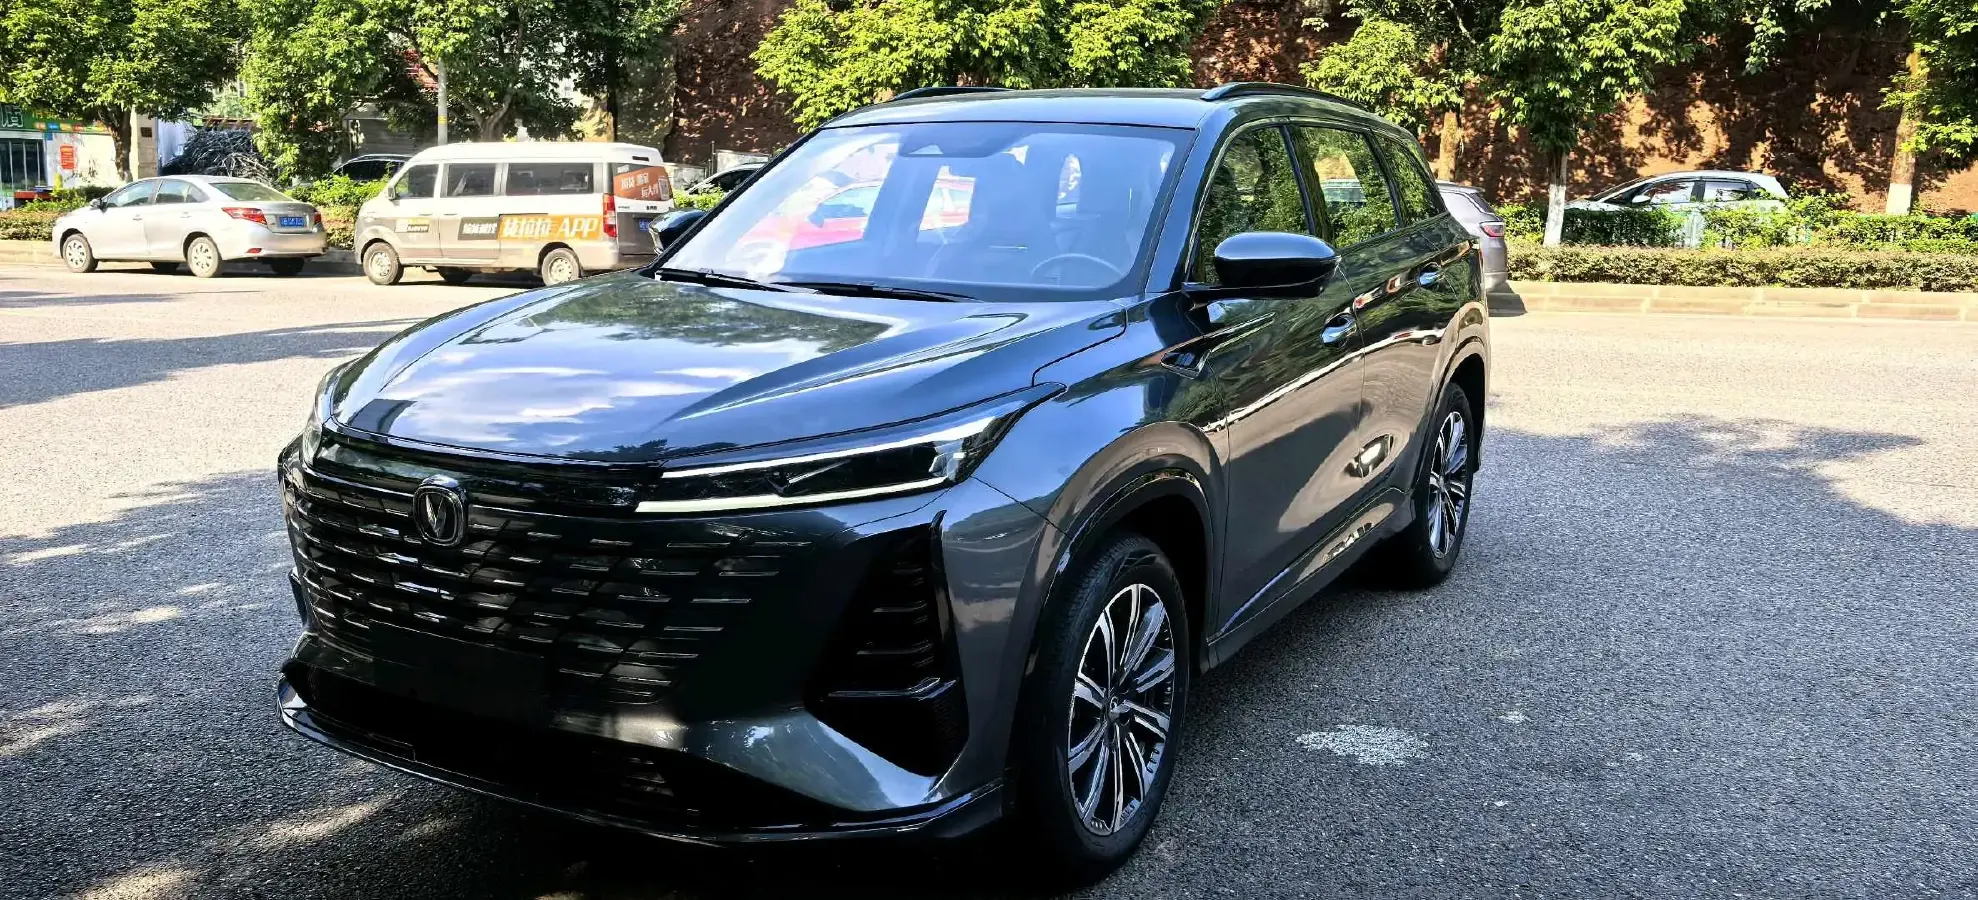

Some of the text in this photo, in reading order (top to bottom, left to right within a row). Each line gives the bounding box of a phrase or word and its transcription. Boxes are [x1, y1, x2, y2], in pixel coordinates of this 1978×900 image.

[1, 104, 24, 128] 店
[502, 216, 552, 238] 货拉拉
[558, 216, 599, 238] APP
